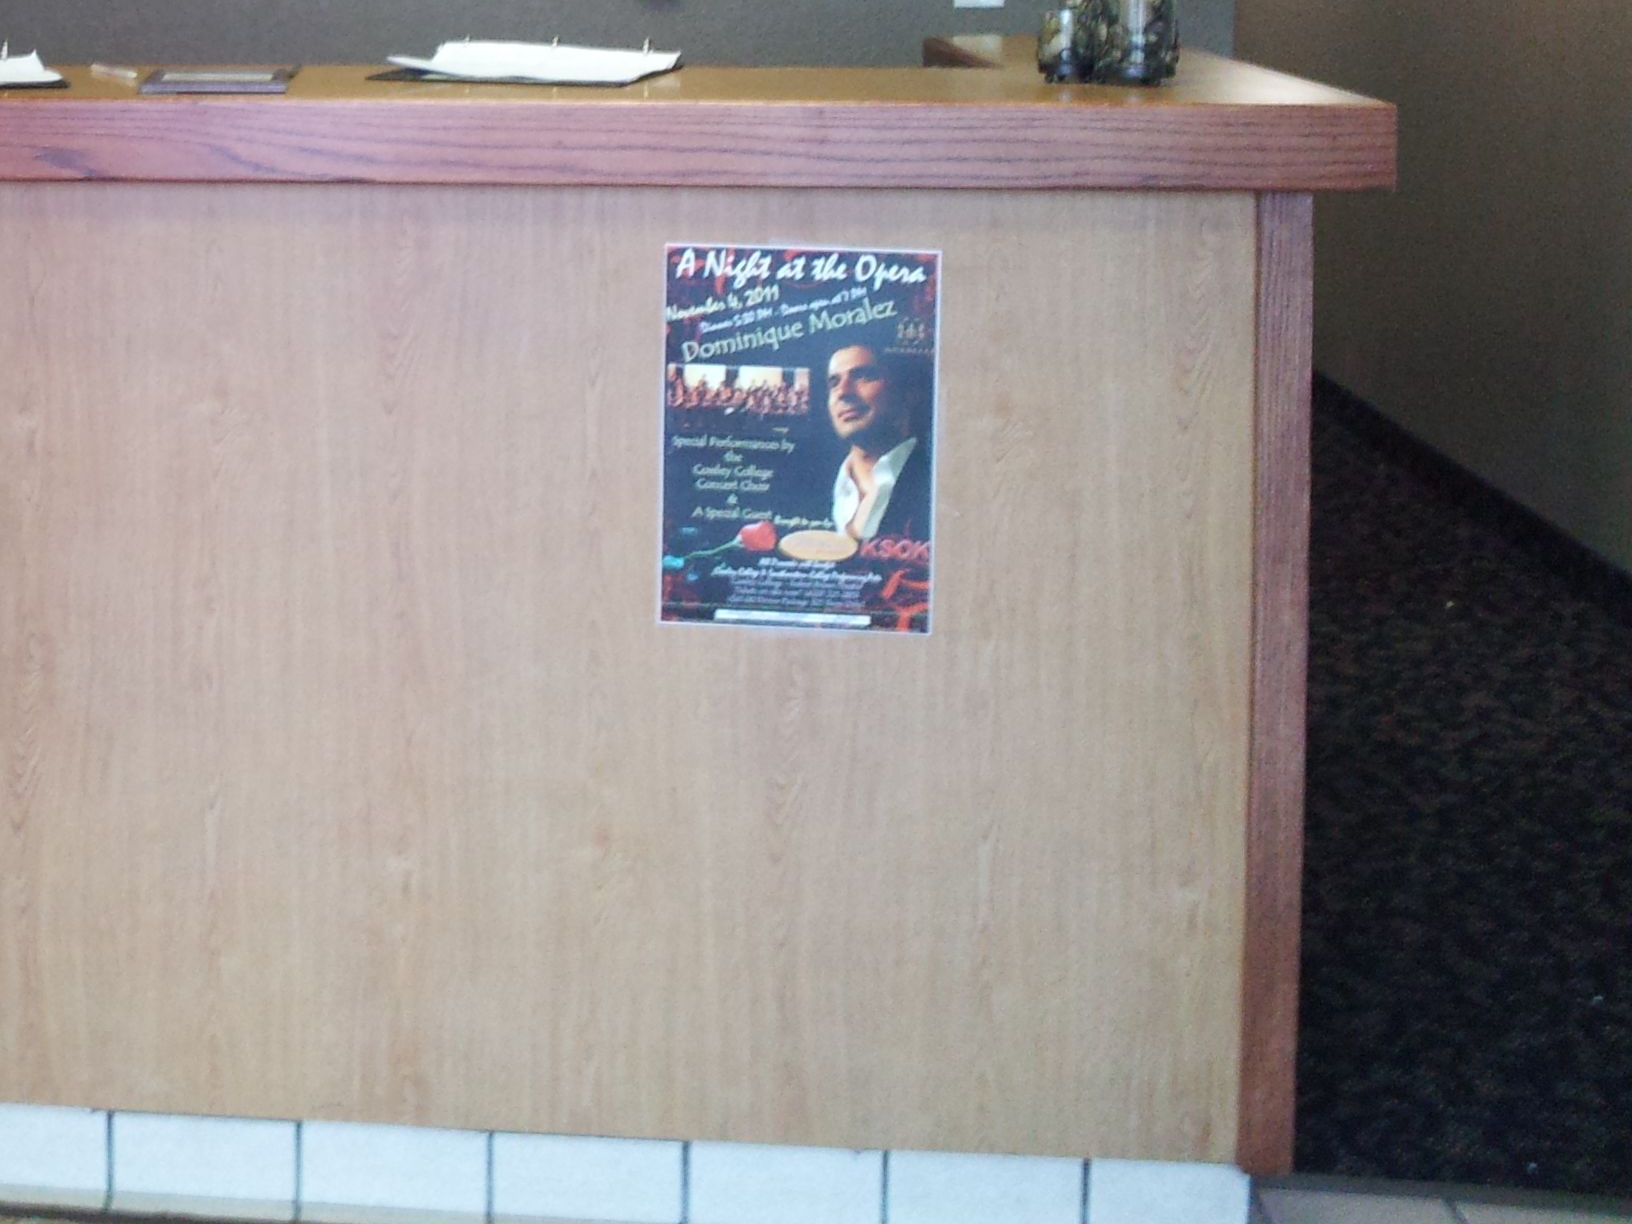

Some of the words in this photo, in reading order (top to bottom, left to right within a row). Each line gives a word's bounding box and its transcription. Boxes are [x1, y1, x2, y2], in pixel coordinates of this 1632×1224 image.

[675, 247, 696, 278] A
[703, 249, 772, 288] Night
[776, 254, 807, 280] at
[810, 252, 848, 281] the
[854, 254, 927, 290] Opera
[745, 283, 780, 307] 2011
[681, 319, 804, 363] Dominique
[809, 299, 898, 334] Moralez
[672, 435, 707, 449] Special
